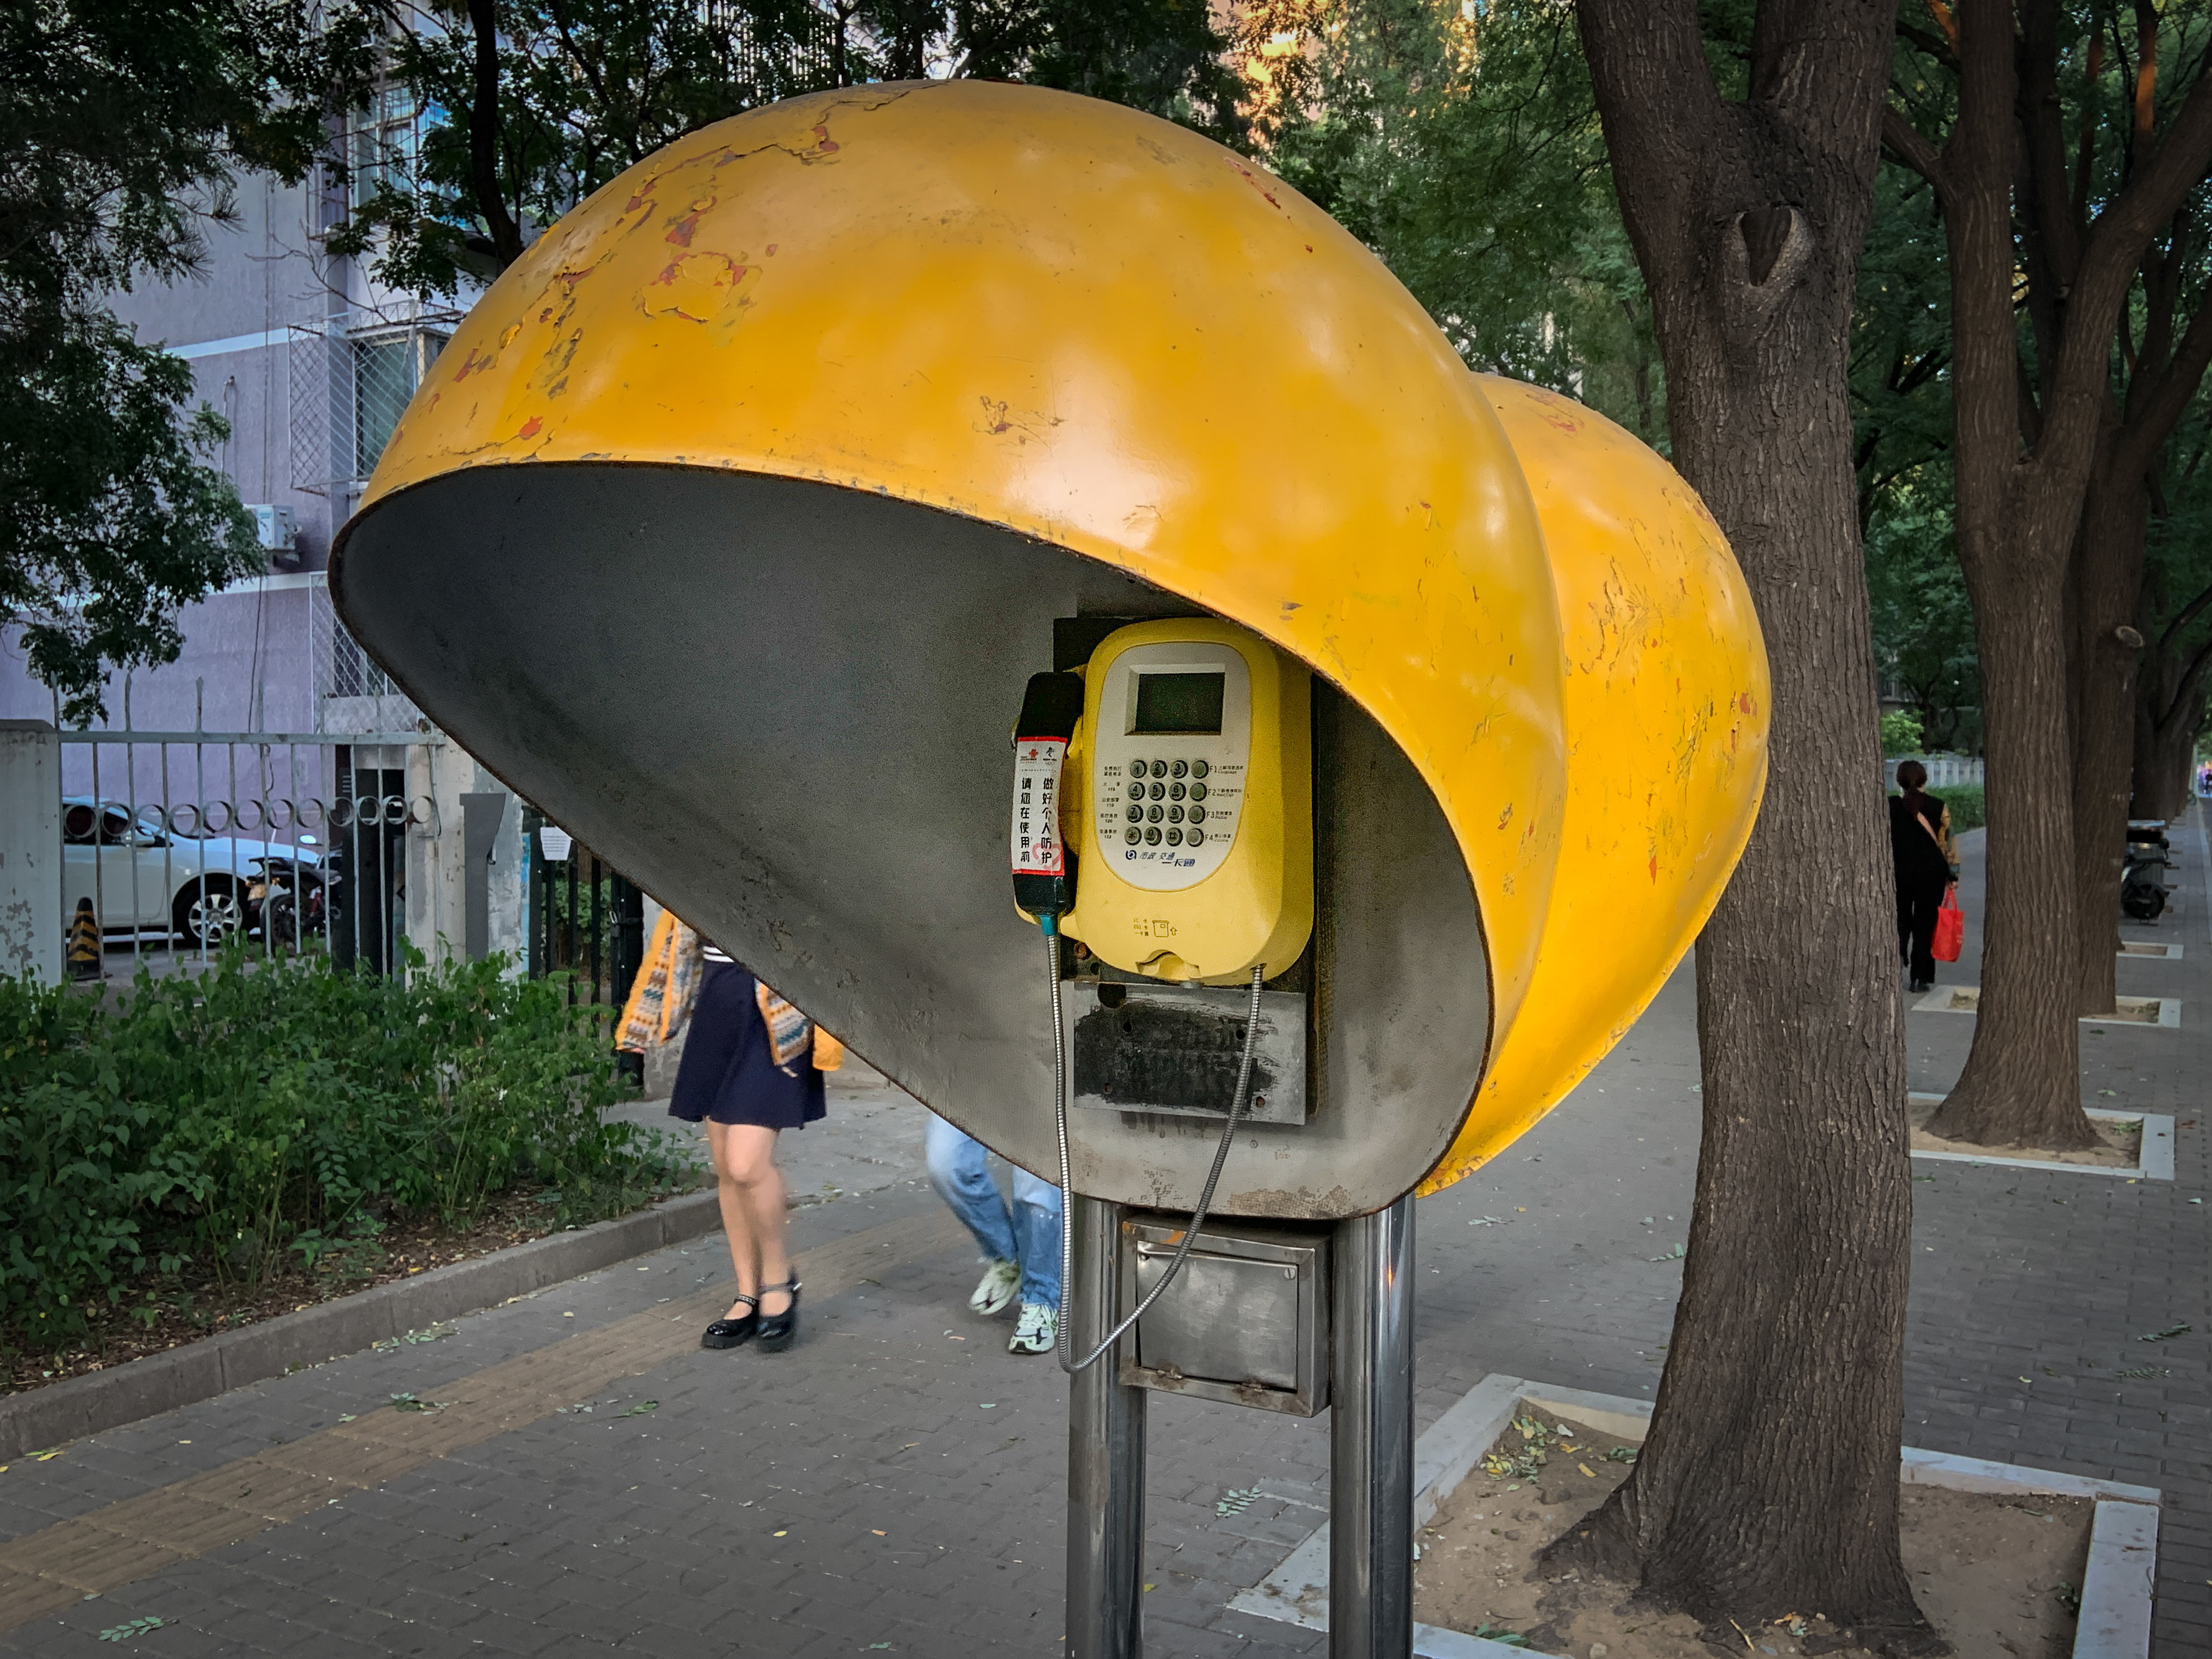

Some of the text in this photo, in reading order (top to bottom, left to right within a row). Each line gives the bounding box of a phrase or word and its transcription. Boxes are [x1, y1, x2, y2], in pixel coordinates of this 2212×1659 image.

[1155, 763, 1160, 772] 2
[1175, 763, 1180, 772] 3
[1153, 785, 1158, 793] 5
[1173, 785, 1179, 793] 6
[1208, 788, 1216, 797] F2
[1131, 807, 1136, 815] 7
[1019, 777, 1032, 862] 请您在使用前
[1041, 777, 1054, 864] 做好个人防护
[1159, 852, 1175, 860] 交通
